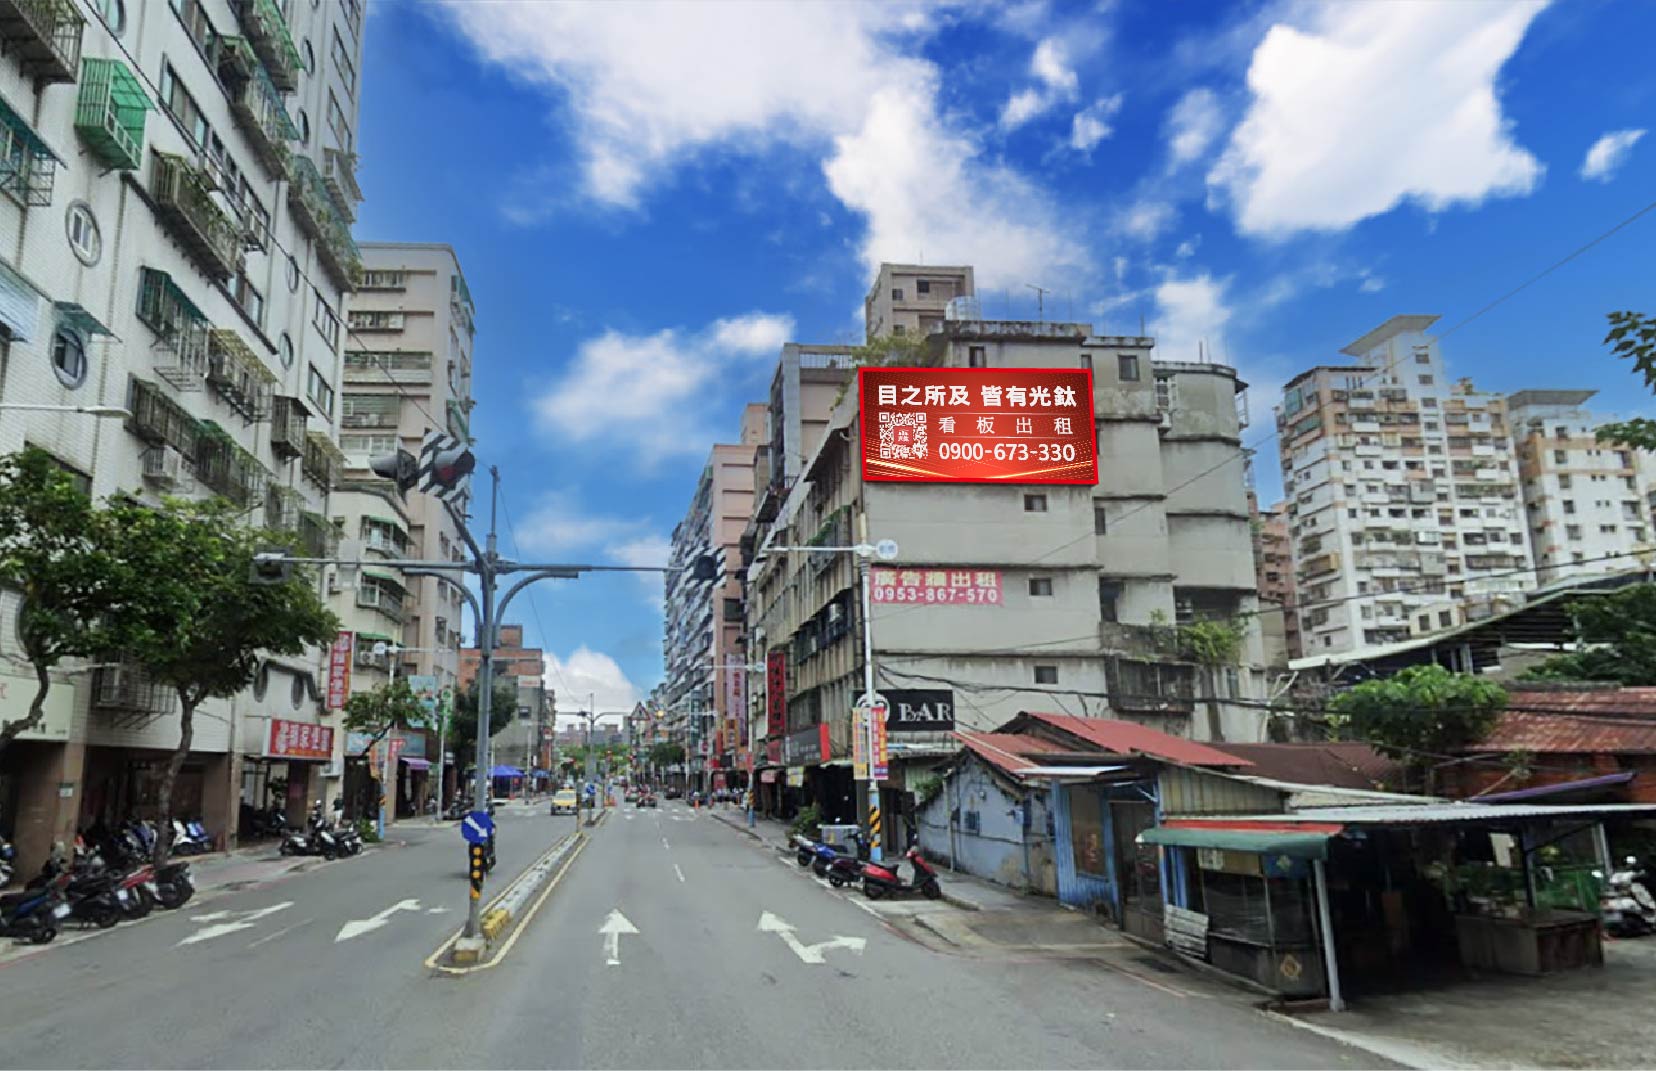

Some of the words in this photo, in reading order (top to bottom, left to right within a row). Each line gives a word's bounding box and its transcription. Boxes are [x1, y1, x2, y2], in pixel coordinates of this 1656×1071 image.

[878, 385, 971, 407] 目之所及
[981, 385, 1077, 407] 皆有光鈦
[938, 416, 1073, 435] 看板出租
[939, 442, 1076, 462] 0900-673-330
[874, 588, 998, 602] 0953-867-570
[898, 702, 953, 721] BAR
